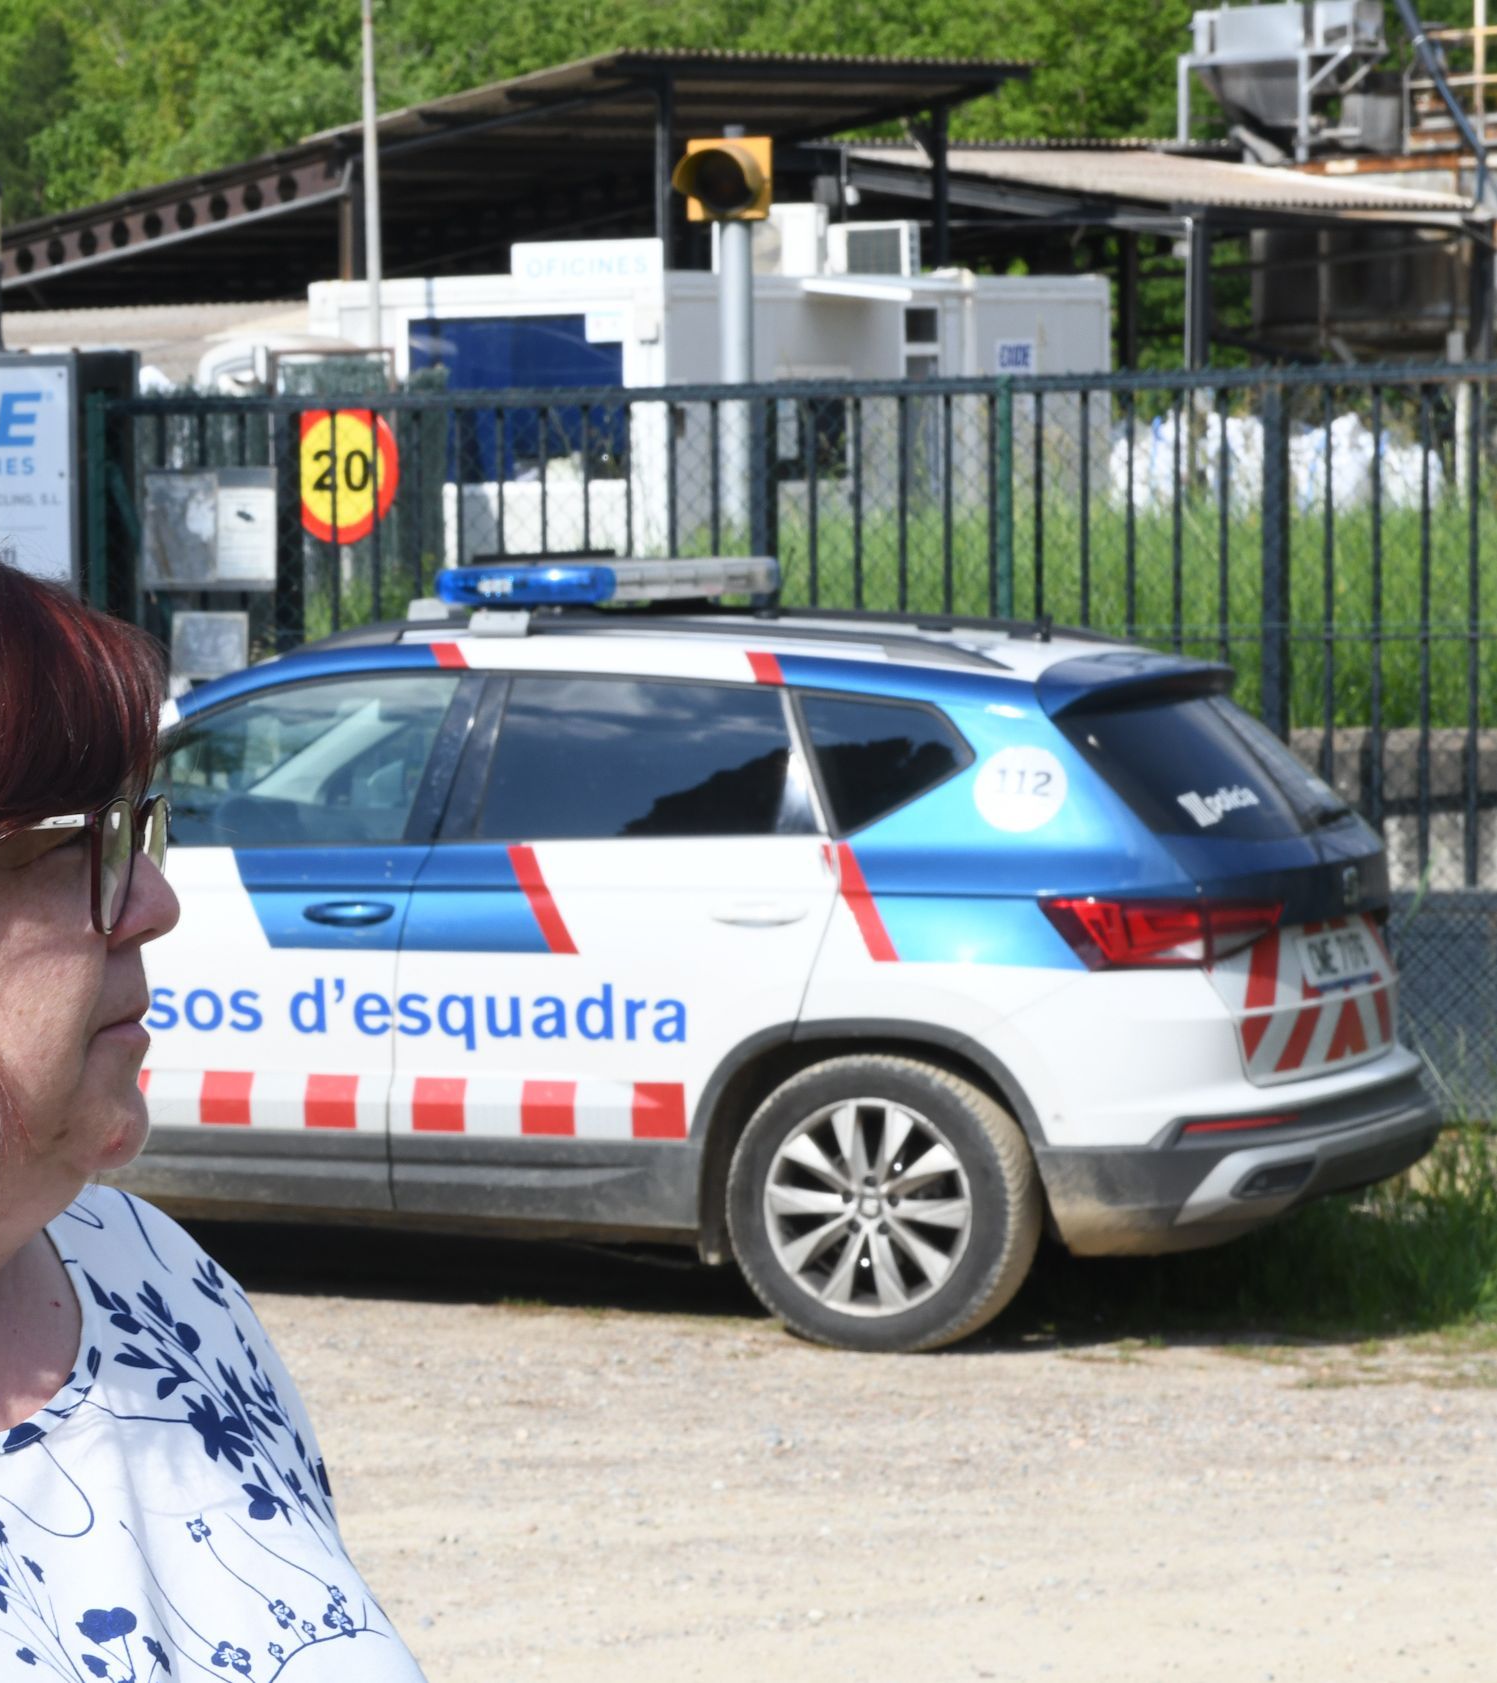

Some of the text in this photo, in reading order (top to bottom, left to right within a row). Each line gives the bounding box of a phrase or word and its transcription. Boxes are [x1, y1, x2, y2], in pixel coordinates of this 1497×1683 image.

[525, 254, 649, 278] OFICINES
[311, 449, 374, 492] 20
[997, 769, 1052, 797] 112
[145, 978, 687, 1051] sos d’esquadra
